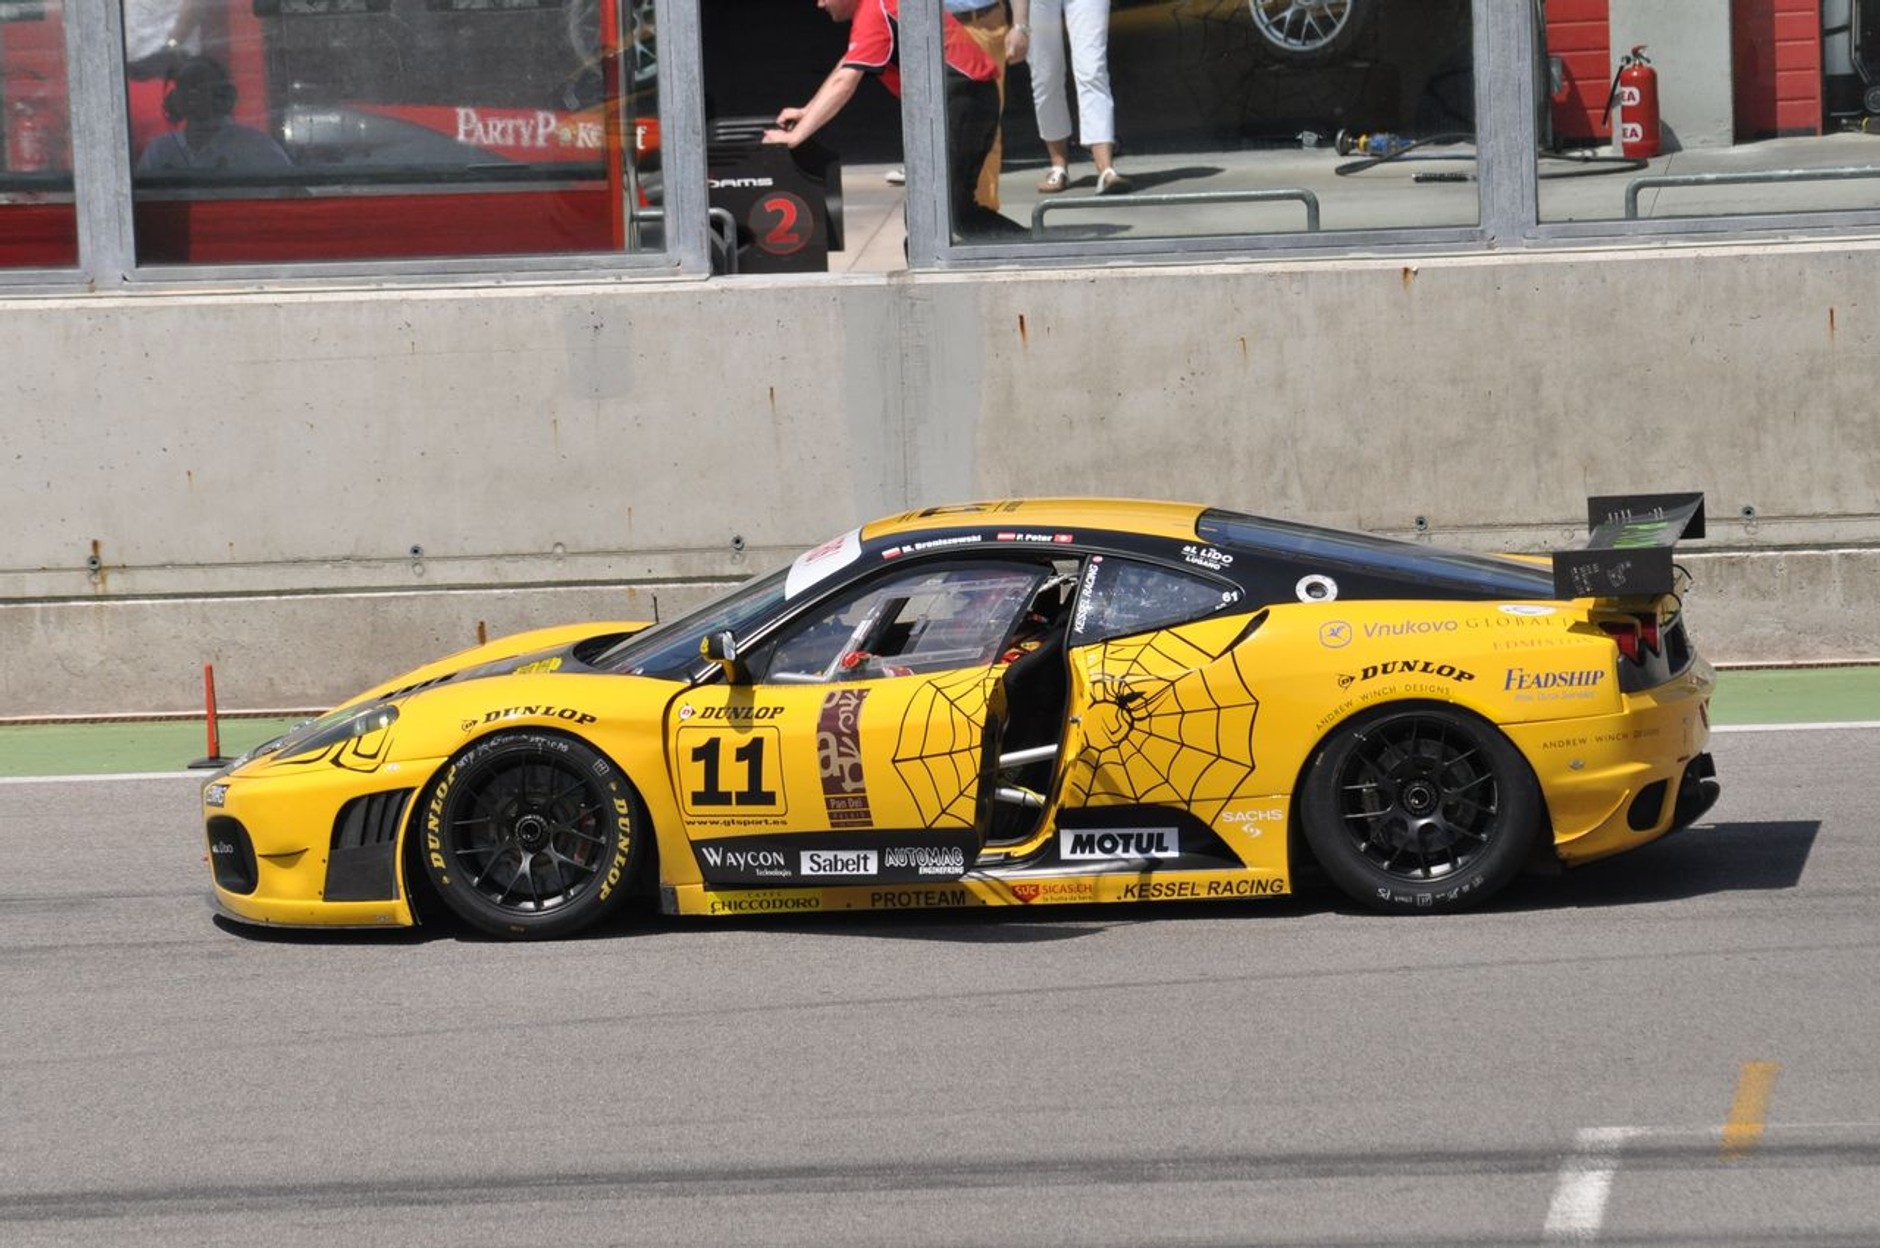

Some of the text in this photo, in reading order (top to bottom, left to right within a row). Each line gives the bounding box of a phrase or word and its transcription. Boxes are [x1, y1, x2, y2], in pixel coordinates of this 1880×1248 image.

[764, 198, 800, 244] 2
[1082, 563, 1099, 598] RACING
[1363, 620, 1458, 638] Vnukovo
[1360, 660, 1476, 683] DUNLOP
[482, 705, 597, 725] DUNLOP
[699, 706, 785, 719] DUNLOP
[1315, 684, 1451, 731] ANDREW WINCH DESIGNS
[1542, 738, 1588, 750] ANDREW
[691, 736, 776, 806] 11
[427, 764, 457, 869] DUNLOP
[1222, 809, 1283, 823] SACHS
[599, 797, 630, 901] DUNLOP
[1070, 832, 1169, 855] MOTUL
[809, 853, 870, 873] Sabelt
[870, 890, 966, 907] PROTEAM
[1123, 878, 1284, 898] KESSEL RACING
